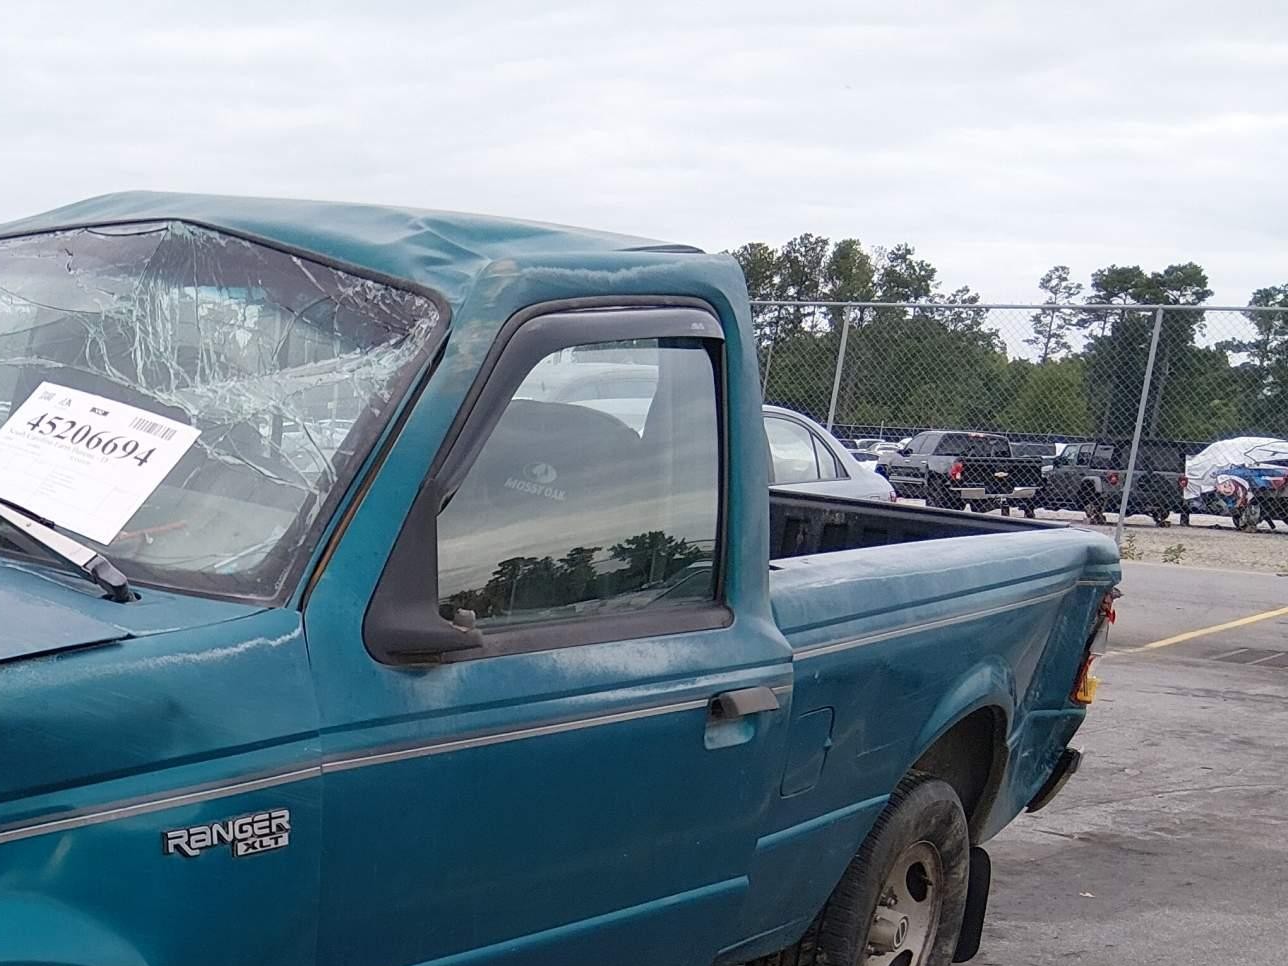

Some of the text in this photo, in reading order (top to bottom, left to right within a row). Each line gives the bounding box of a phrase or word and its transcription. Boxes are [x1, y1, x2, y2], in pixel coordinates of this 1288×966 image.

[26, 412, 158, 467] 45206694
[503, 475, 566, 501] MOSSY OAK
[166, 808, 291, 857] RANGER
[242, 834, 284, 854] XLT
